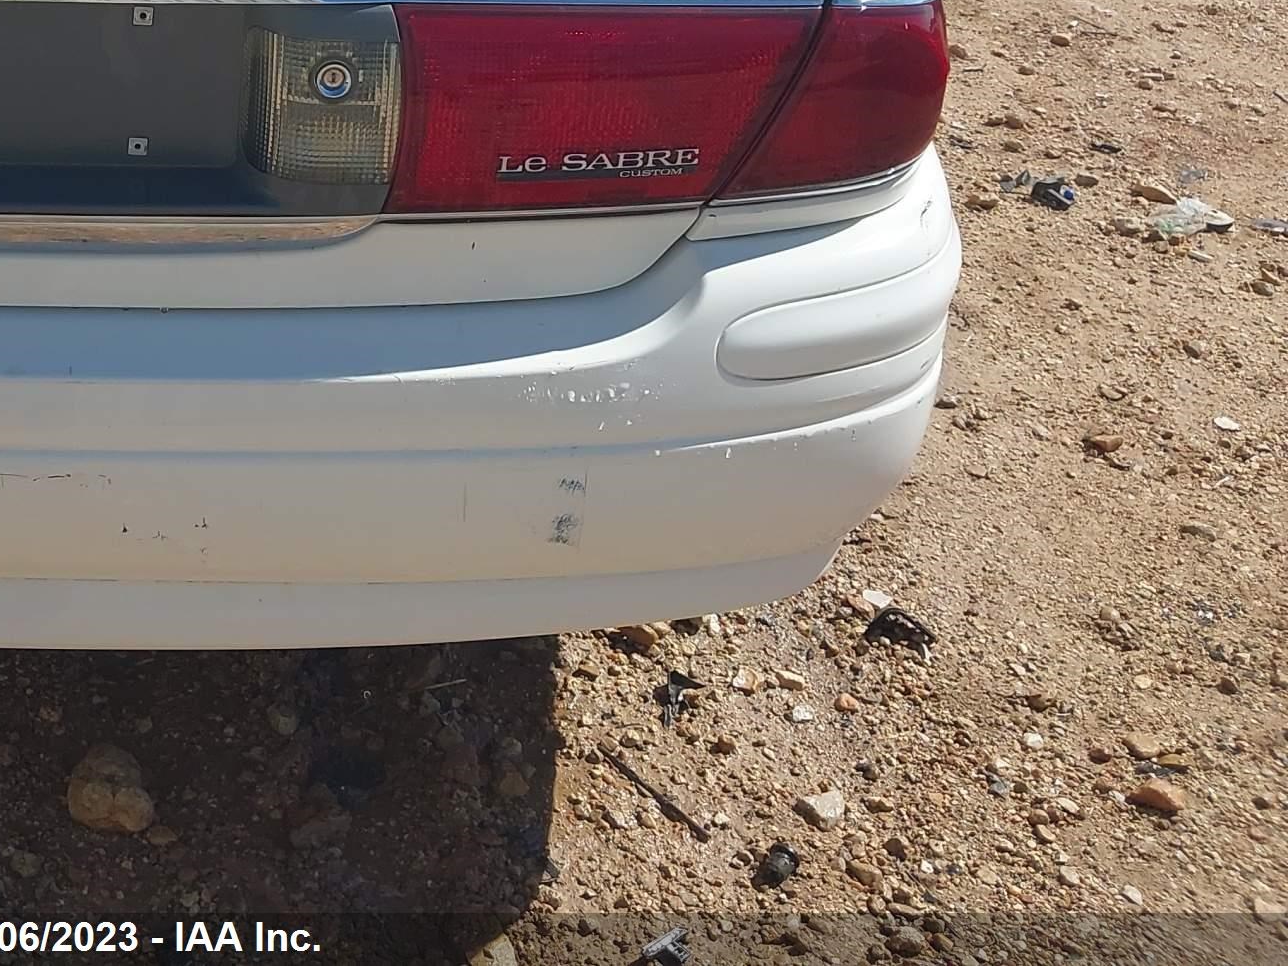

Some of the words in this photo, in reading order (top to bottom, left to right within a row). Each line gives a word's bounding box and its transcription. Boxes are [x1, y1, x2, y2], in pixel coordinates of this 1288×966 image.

[496, 155, 547, 173] Le
[562, 148, 700, 172] SABRE
[619, 166, 683, 179] CUSTOM
